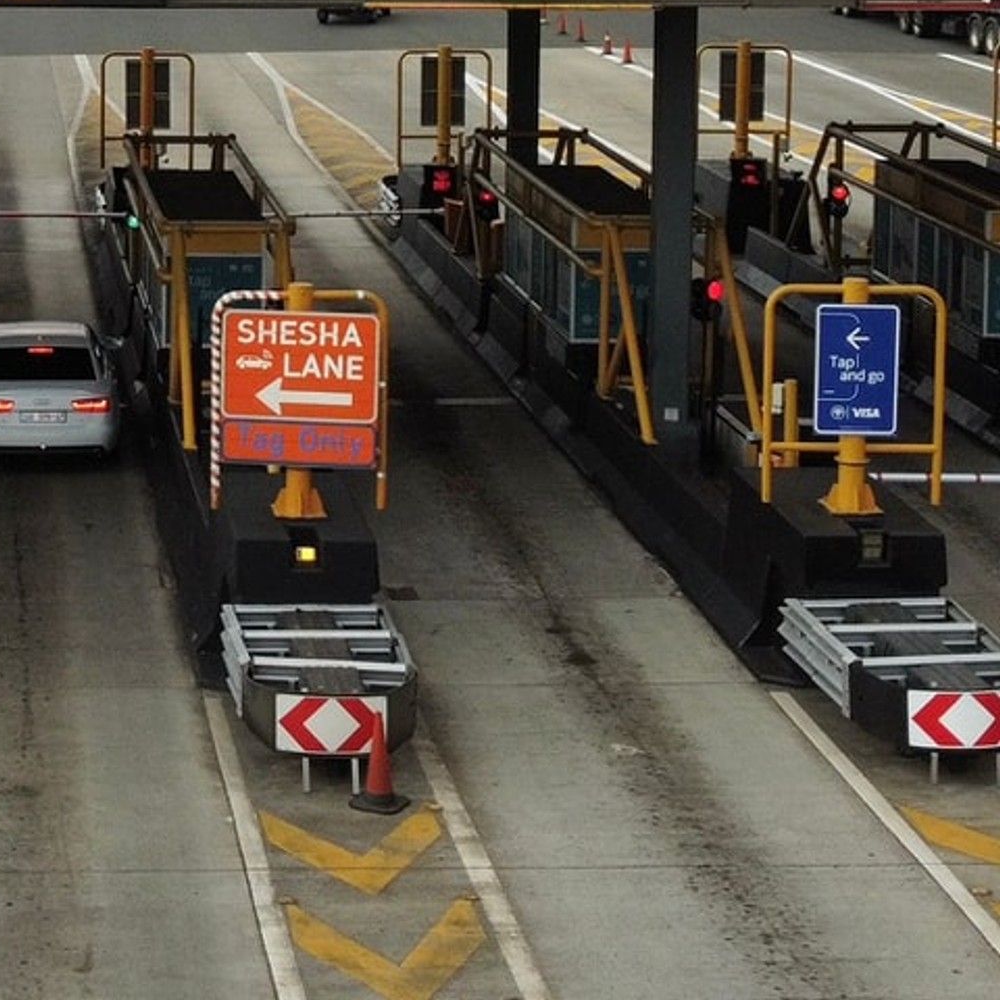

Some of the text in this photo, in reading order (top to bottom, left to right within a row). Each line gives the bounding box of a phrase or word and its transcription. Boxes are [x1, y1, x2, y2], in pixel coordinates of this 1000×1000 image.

[237, 318, 363, 347] SHESHA
[283, 351, 364, 381] LANE
[829, 355, 855, 370] Tap
[839, 369, 885, 385] and go
[852, 407, 880, 418] VISA
[239, 423, 363, 462] Tag Only
